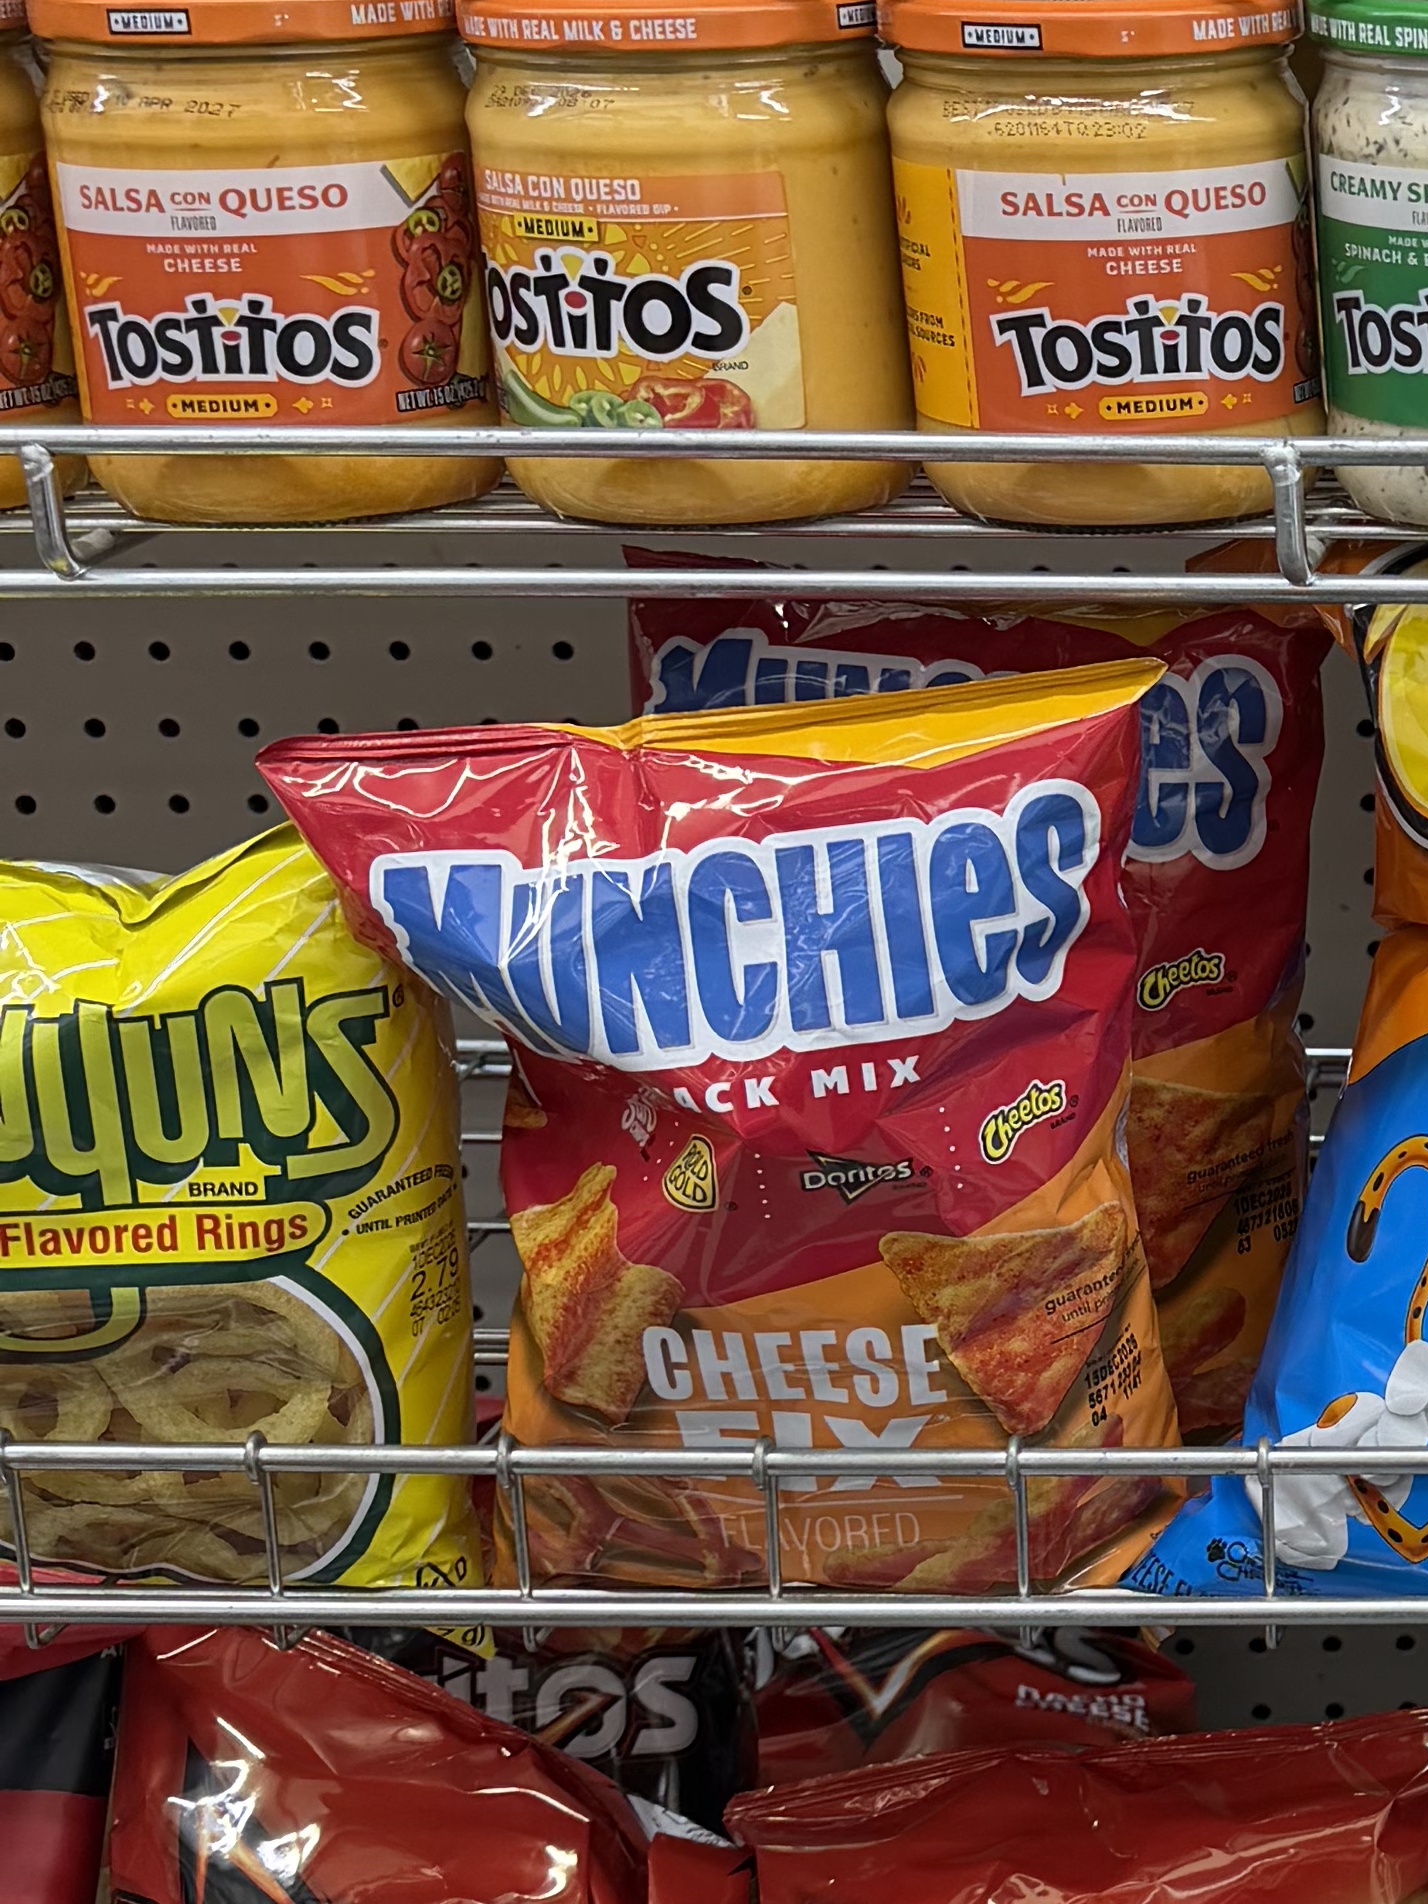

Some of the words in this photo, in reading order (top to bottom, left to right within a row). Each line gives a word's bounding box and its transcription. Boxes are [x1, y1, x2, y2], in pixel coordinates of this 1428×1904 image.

[120, 13, 178, 31] MEDIUM
[517, 20, 559, 40] REAL
[564, 20, 604, 41] MILK
[610, 20, 623, 40] &
[629, 18, 697, 40] CHEESE
[79, 184, 165, 214] SALSA
[170, 190, 212, 208] CON
[218, 183, 348, 212] QUESO
[1330, 170, 1402, 203] CREAMY
[170, 215, 217, 232] FLAVORED
[523, 219, 586, 238] MEDIUM
[164, 257, 242, 273] CHEESE
[1344, 242, 1402, 267] SPINACH
[1407, 250, 1419, 267] &
[180, 397, 259, 415] MEDIUM
[812, 1055, 923, 1098] MIX
[978, 1078, 1067, 1165] Cheetos
[189, 1181, 259, 1197] BRAND
[669, 1164, 708, 1205] GOLD
[803, 1160, 914, 1192] Doritos
[1, 1216, 179, 1258] Flavored
[195, 1212, 308, 1254] Rings
[644, 1324, 949, 1405] CHEESE
[717, 1512, 920, 1553] FLAVORED
